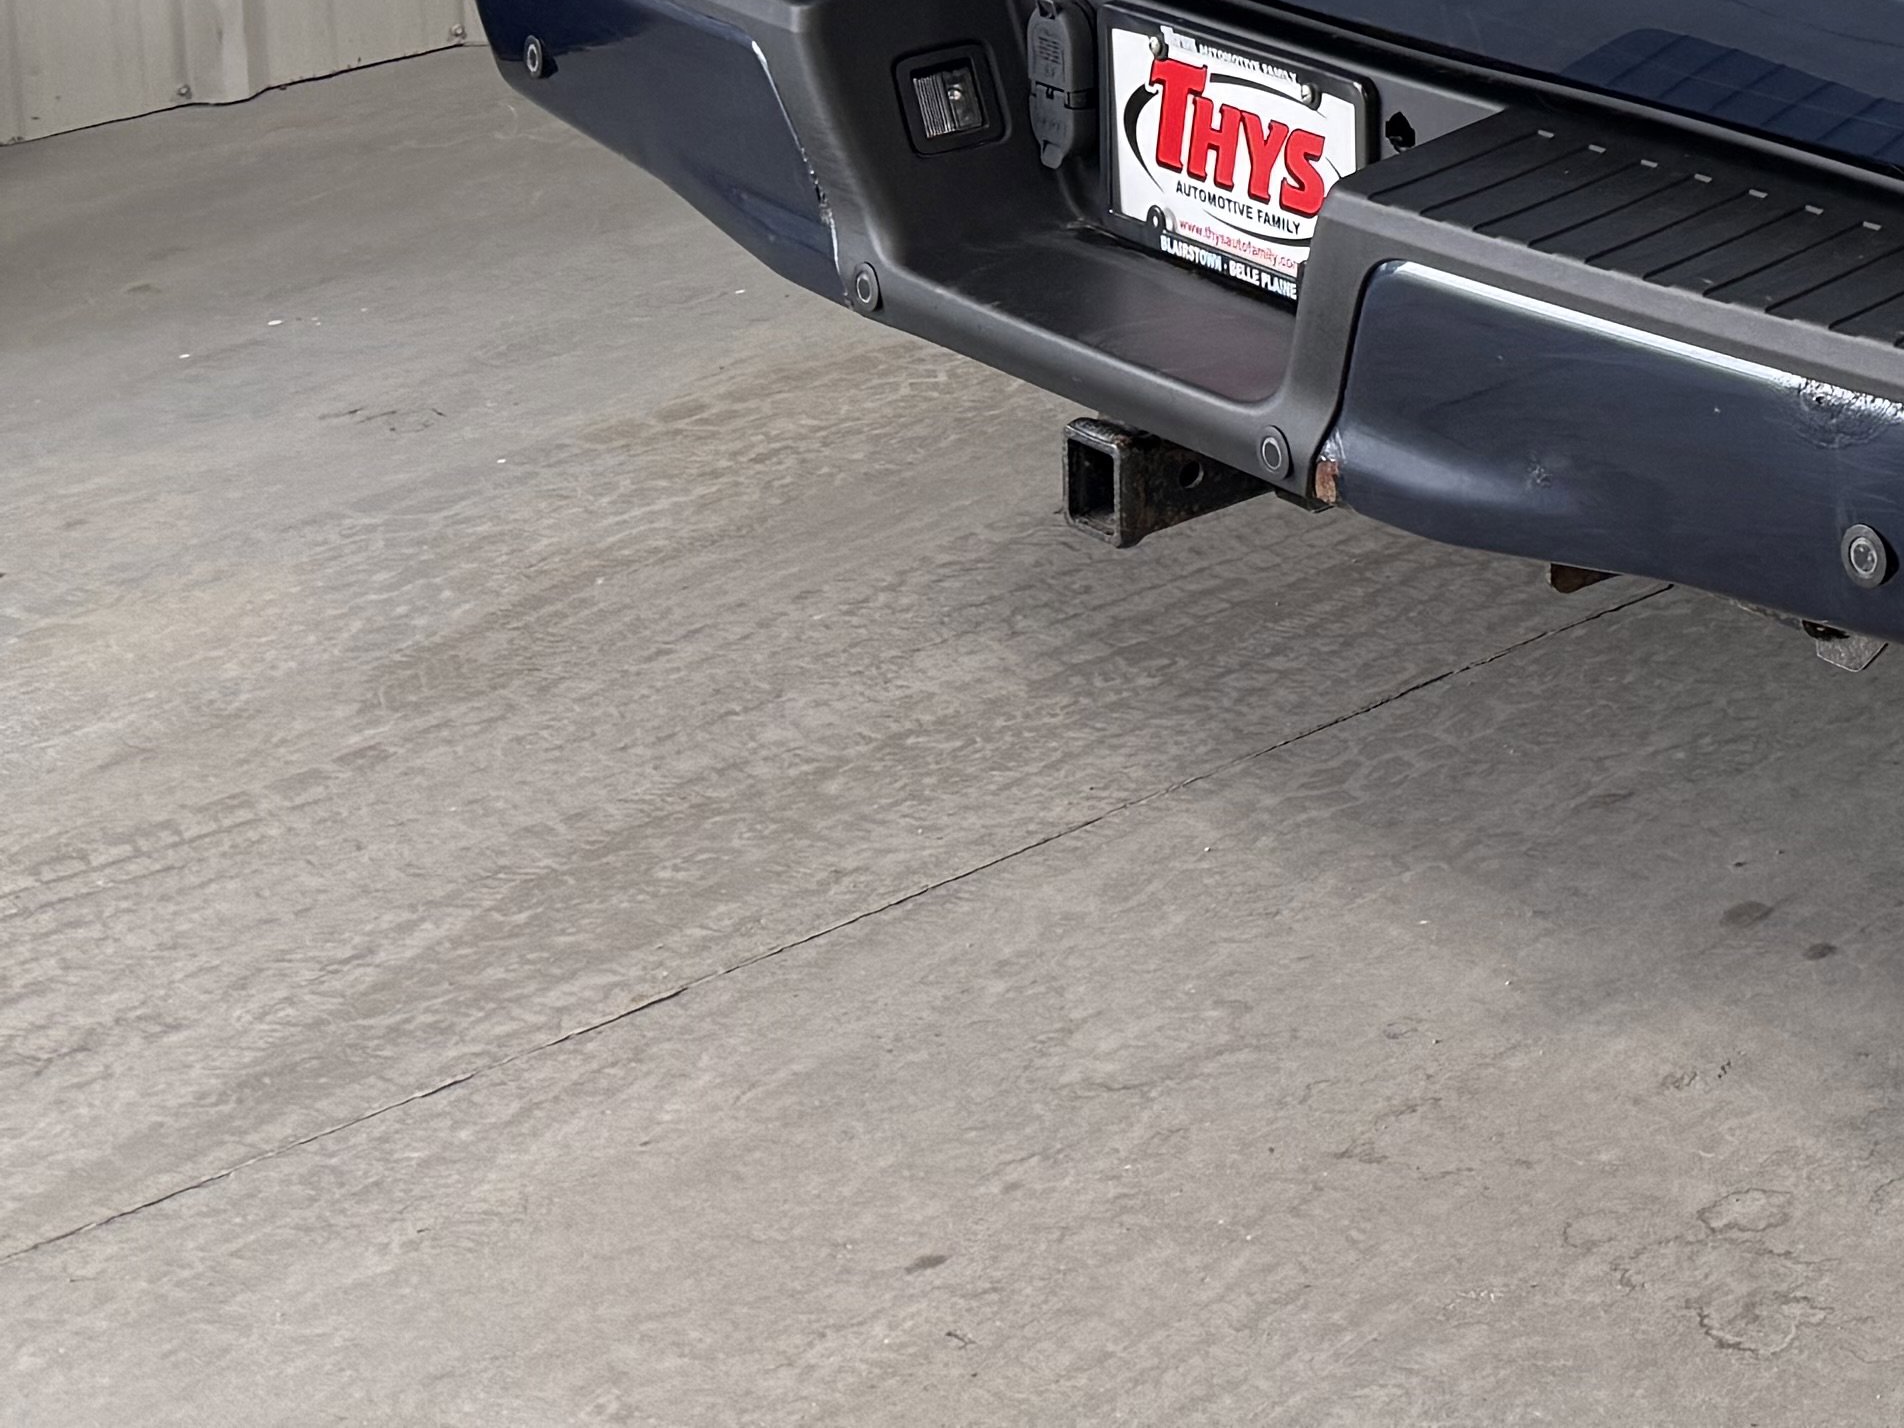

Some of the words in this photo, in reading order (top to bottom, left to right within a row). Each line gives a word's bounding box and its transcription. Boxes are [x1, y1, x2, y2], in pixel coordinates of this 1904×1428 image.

[1149, 56, 1325, 219] THYS
[1176, 180, 1253, 220] AUTOMOTIVE
[1257, 210, 1300, 235] FAMILY
[1160, 235, 1222, 272] BLAIRSTOWN
[1229, 261, 1260, 286] BELLE
